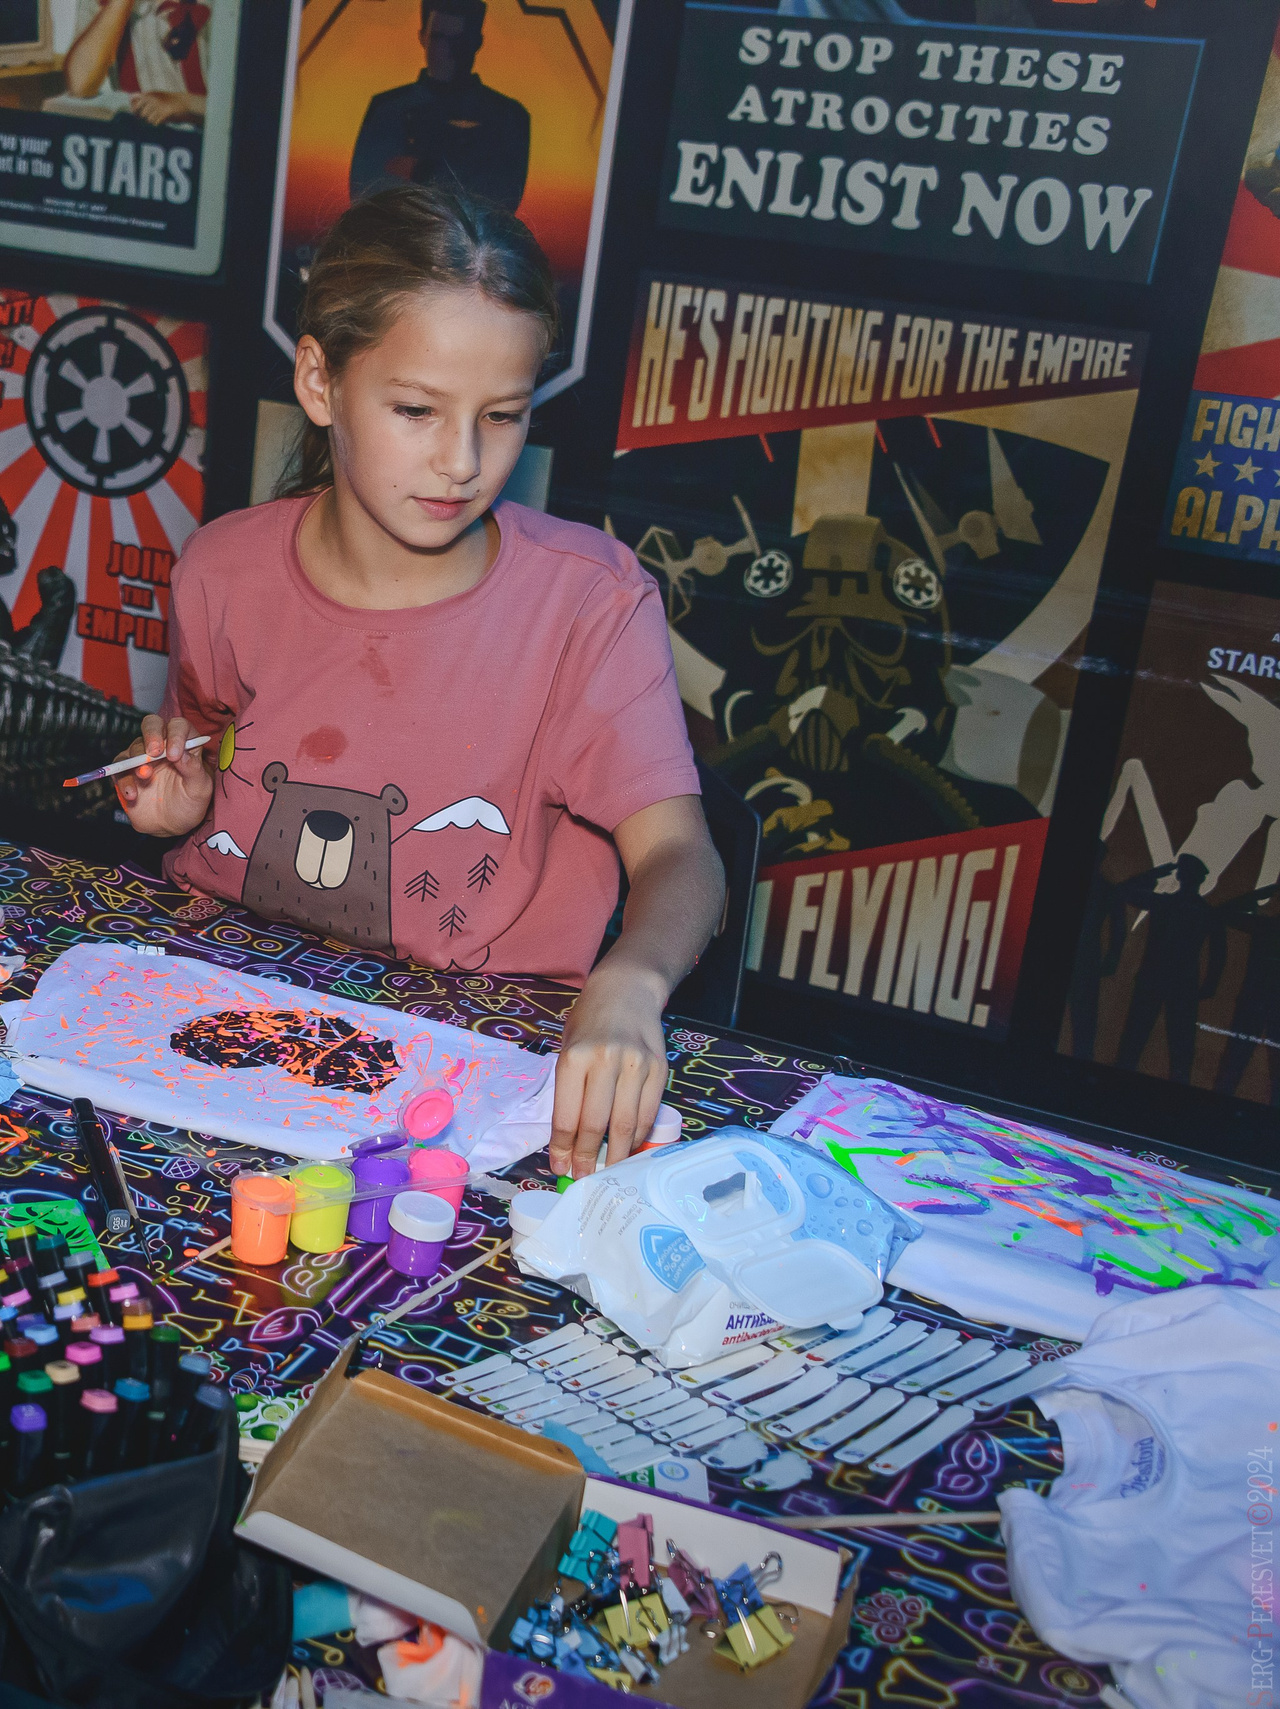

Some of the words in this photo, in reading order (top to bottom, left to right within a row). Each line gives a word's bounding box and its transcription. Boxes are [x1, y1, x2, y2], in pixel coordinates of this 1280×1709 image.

[738, 27, 894, 76] STOP
[916, 40, 1125, 95] THESE
[727, 84, 1112, 156] ATROCITIES
[60, 132, 193, 205] STARS
[669, 139, 939, 230] ENLIST
[951, 170, 1153, 253] NOW
[631, 280, 728, 429] HE'S
[719, 293, 885, 420] FIGHTING
[881, 313, 954, 402] FOR
[956, 322, 1019, 394] THE
[1019, 331, 1133, 387] EMPIRE
[106, 541, 173, 588] JOIN
[777, 844, 1021, 1029] FLYING!
